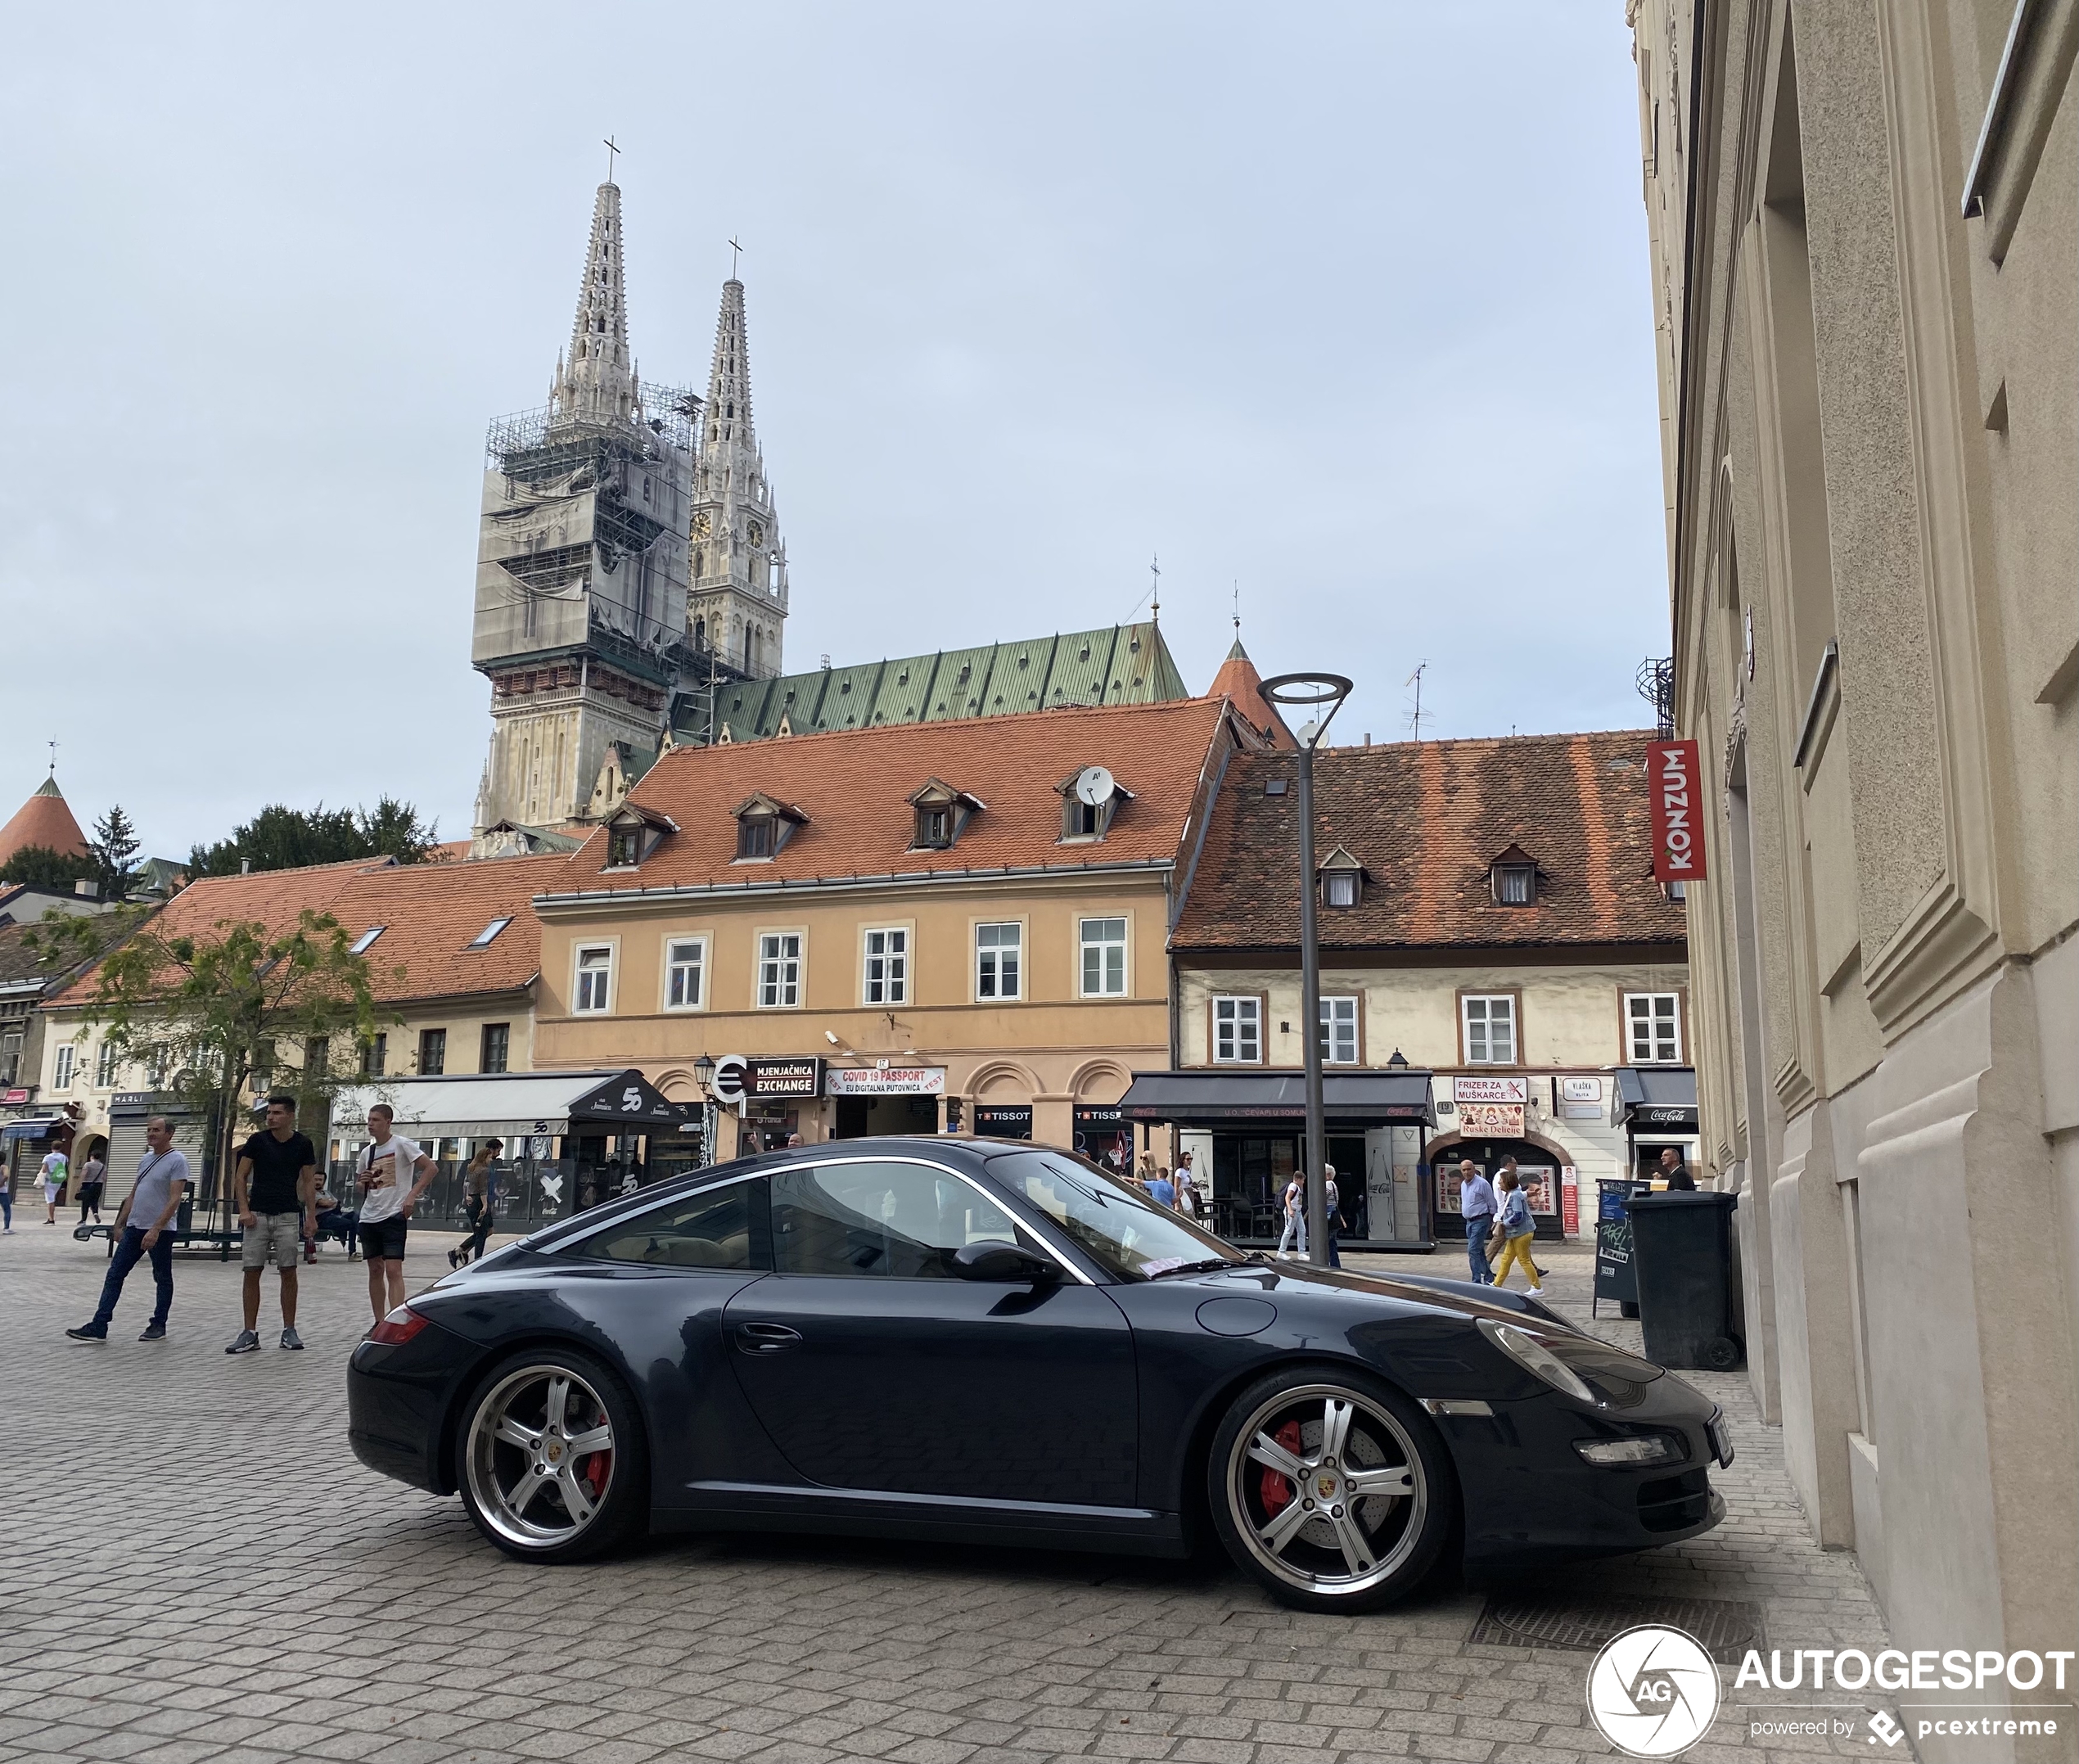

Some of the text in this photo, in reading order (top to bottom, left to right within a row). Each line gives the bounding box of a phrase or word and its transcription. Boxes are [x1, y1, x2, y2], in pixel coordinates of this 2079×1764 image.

[1662, 749, 1692, 869] KONZUM
[757, 1064, 813, 1076] MJENJAČNICA
[842, 1070, 926, 1082] COVID 19 PASSPORT
[756, 1080, 812, 1091] EXCHANGE
[827, 1075, 841, 1091] TEST
[924, 1075, 942, 1090] TEST
[1490, 1081, 1502, 1090] ZA
[1572, 1081, 1592, 1090] VLAŠKA
[886, 1084, 920, 1092] PUTOVNICA
[115, 1095, 142, 1103] MARLI
[621, 1087, 642, 1112] 50
[1459, 1090, 1506, 1099] MUŠKARCE
[992, 1112, 1030, 1121] TISSOT
[1091, 1112, 1116, 1120] TISS
[1463, 1125, 1521, 1135] Ruske Delicije
[1543, 1169, 1551, 1211] FRIZER
